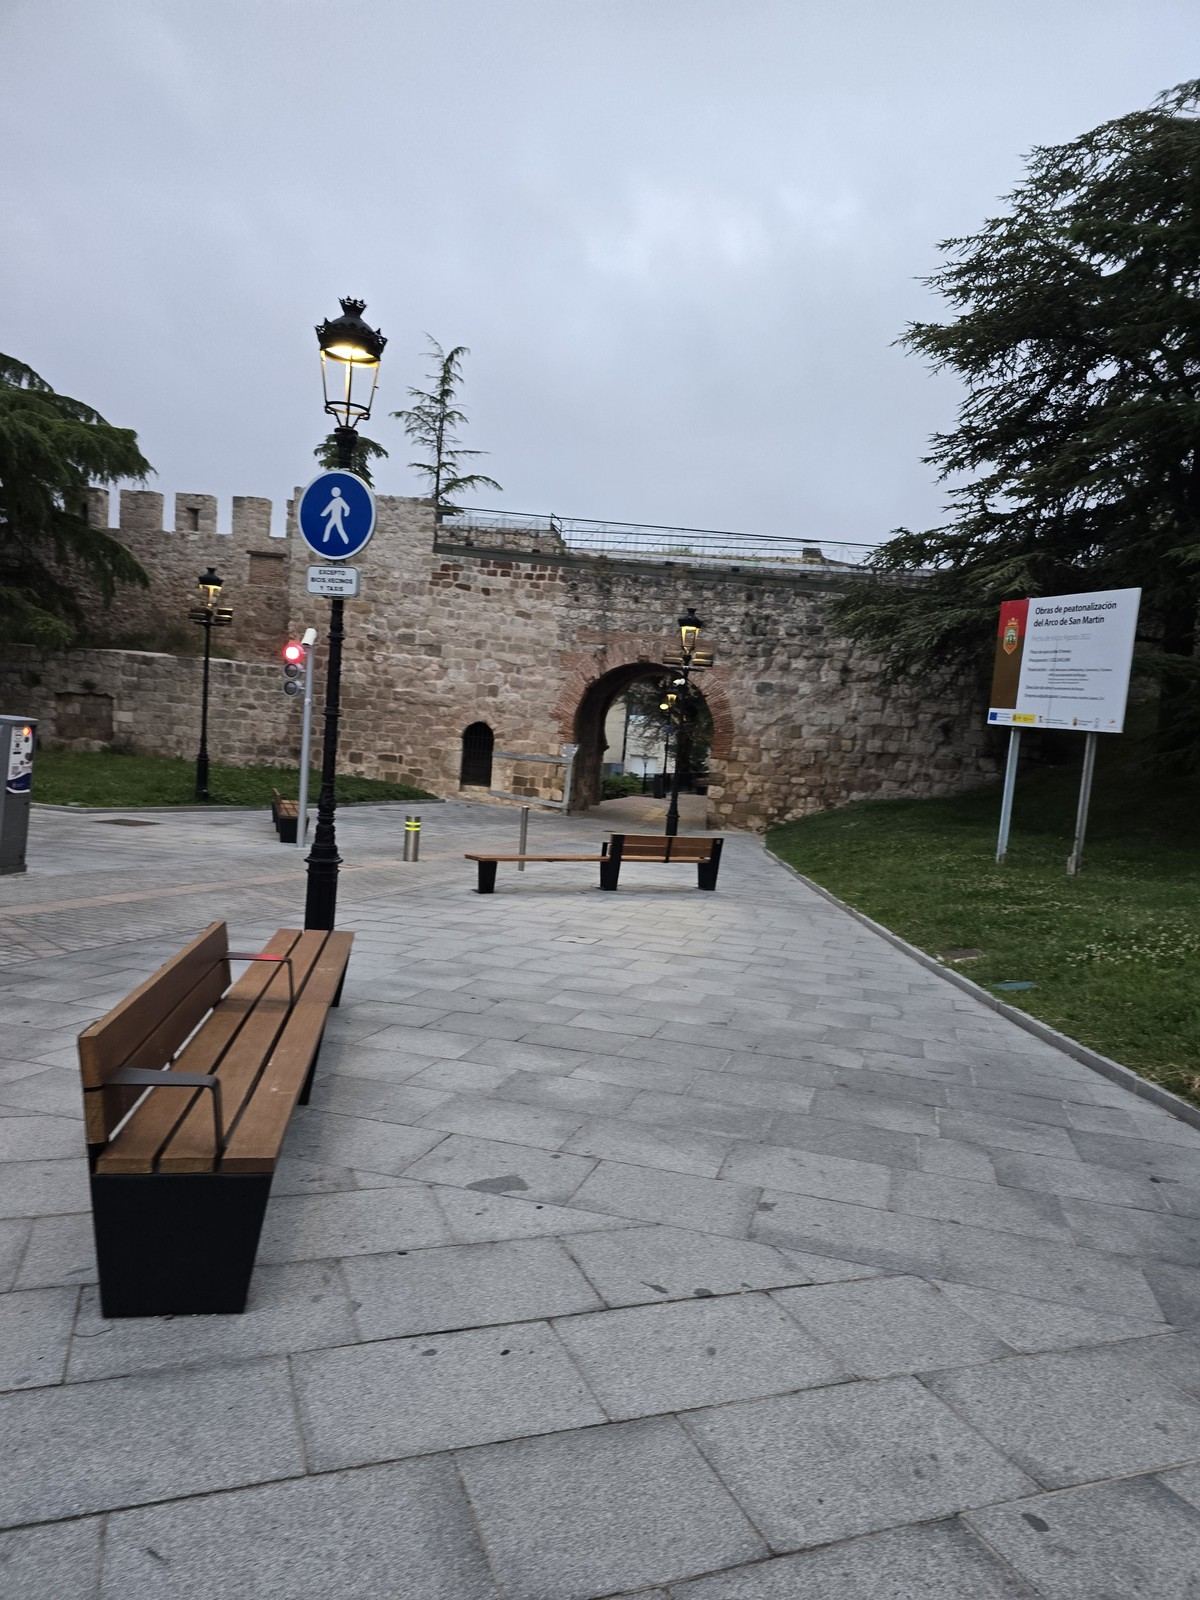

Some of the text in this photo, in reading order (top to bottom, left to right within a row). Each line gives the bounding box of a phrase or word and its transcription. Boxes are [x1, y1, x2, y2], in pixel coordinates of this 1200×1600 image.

[1035, 601, 1117, 615] Obras de peatonalización
[1033, 619, 1044, 627] del
[1059, 618, 1068, 626] de
[1068, 617, 1081, 625] San
